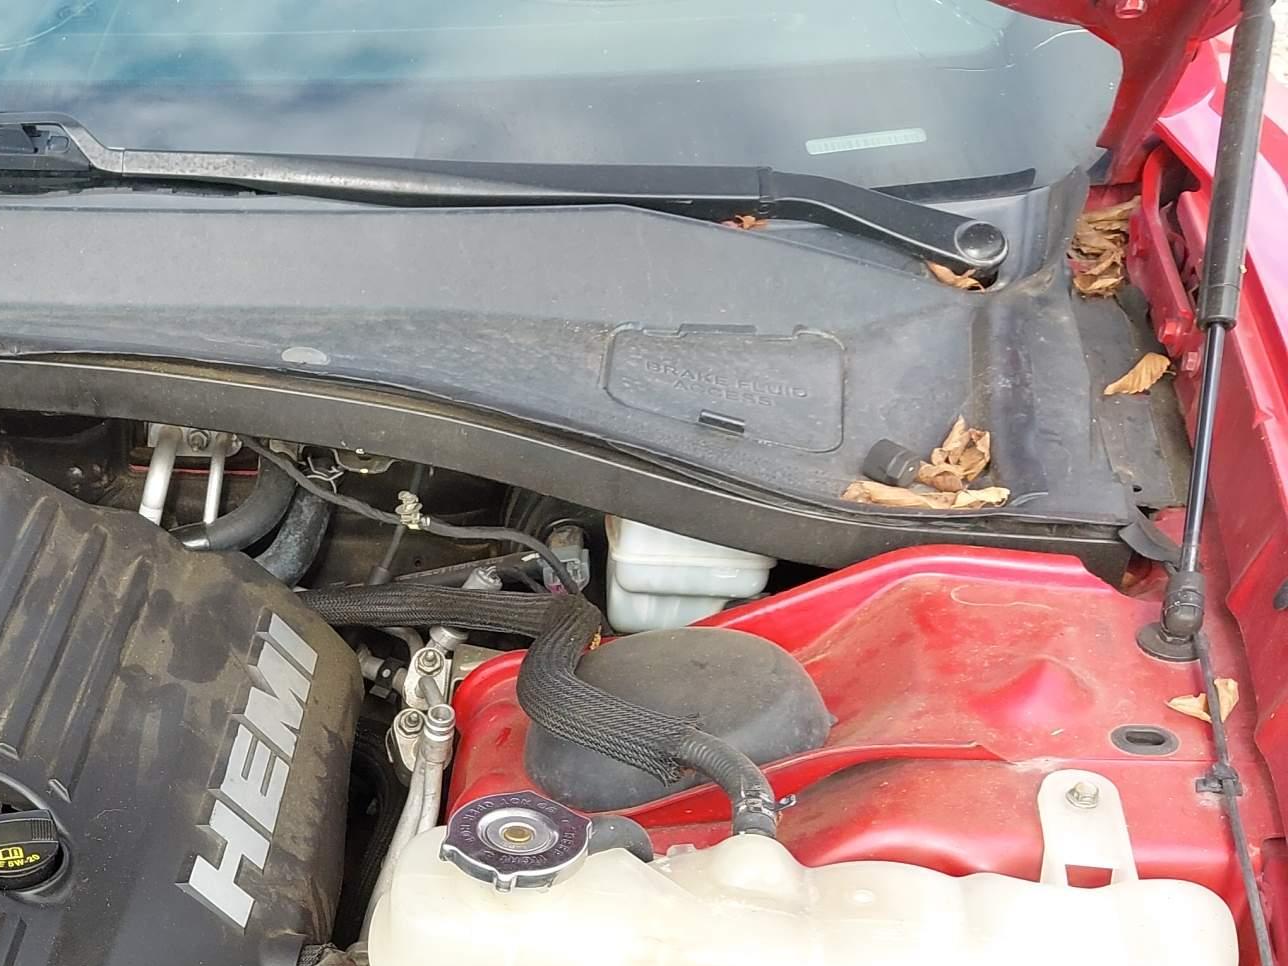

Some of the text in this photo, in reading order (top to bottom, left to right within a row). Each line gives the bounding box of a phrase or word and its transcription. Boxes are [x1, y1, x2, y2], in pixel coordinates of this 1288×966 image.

[646, 360, 809, 399] BRAKE FLUID
[673, 380, 775, 407] ACCESS
[186, 612, 320, 930] HEMI
[8, 854, 41, 868] 5W-20
